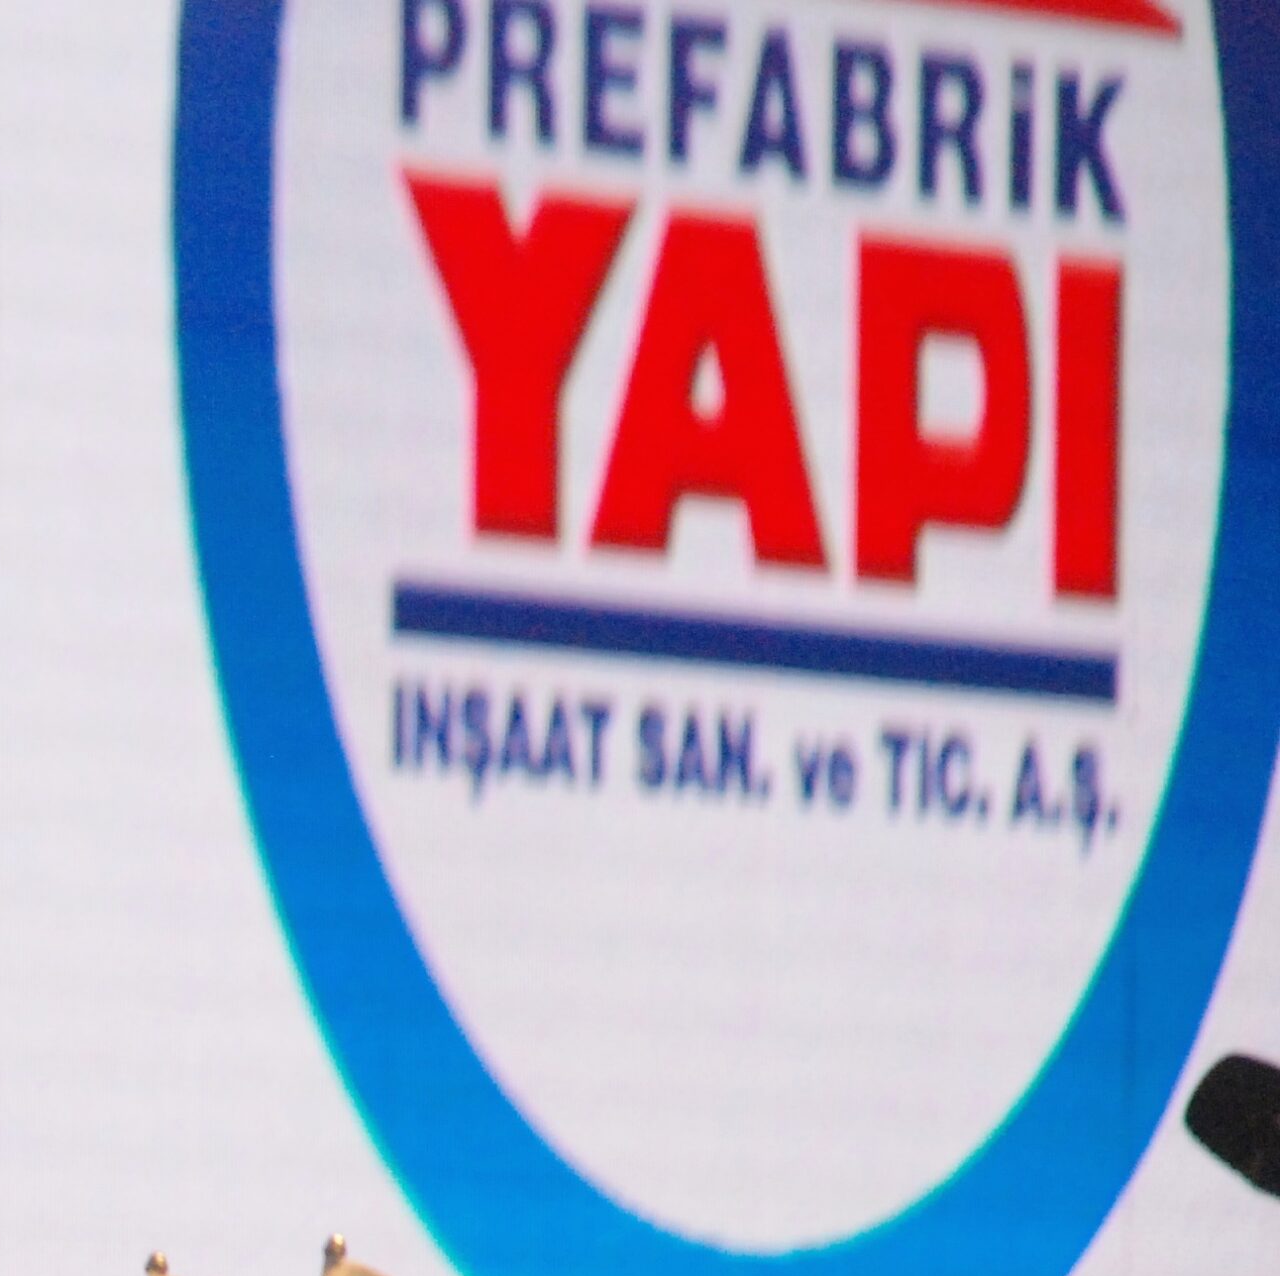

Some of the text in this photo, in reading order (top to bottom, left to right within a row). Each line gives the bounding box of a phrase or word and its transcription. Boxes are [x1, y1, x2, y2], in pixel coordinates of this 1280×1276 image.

[398, 166, 1124, 602] YAPI
[635, 702, 771, 798] SAN.
[796, 732, 858, 808] ve
